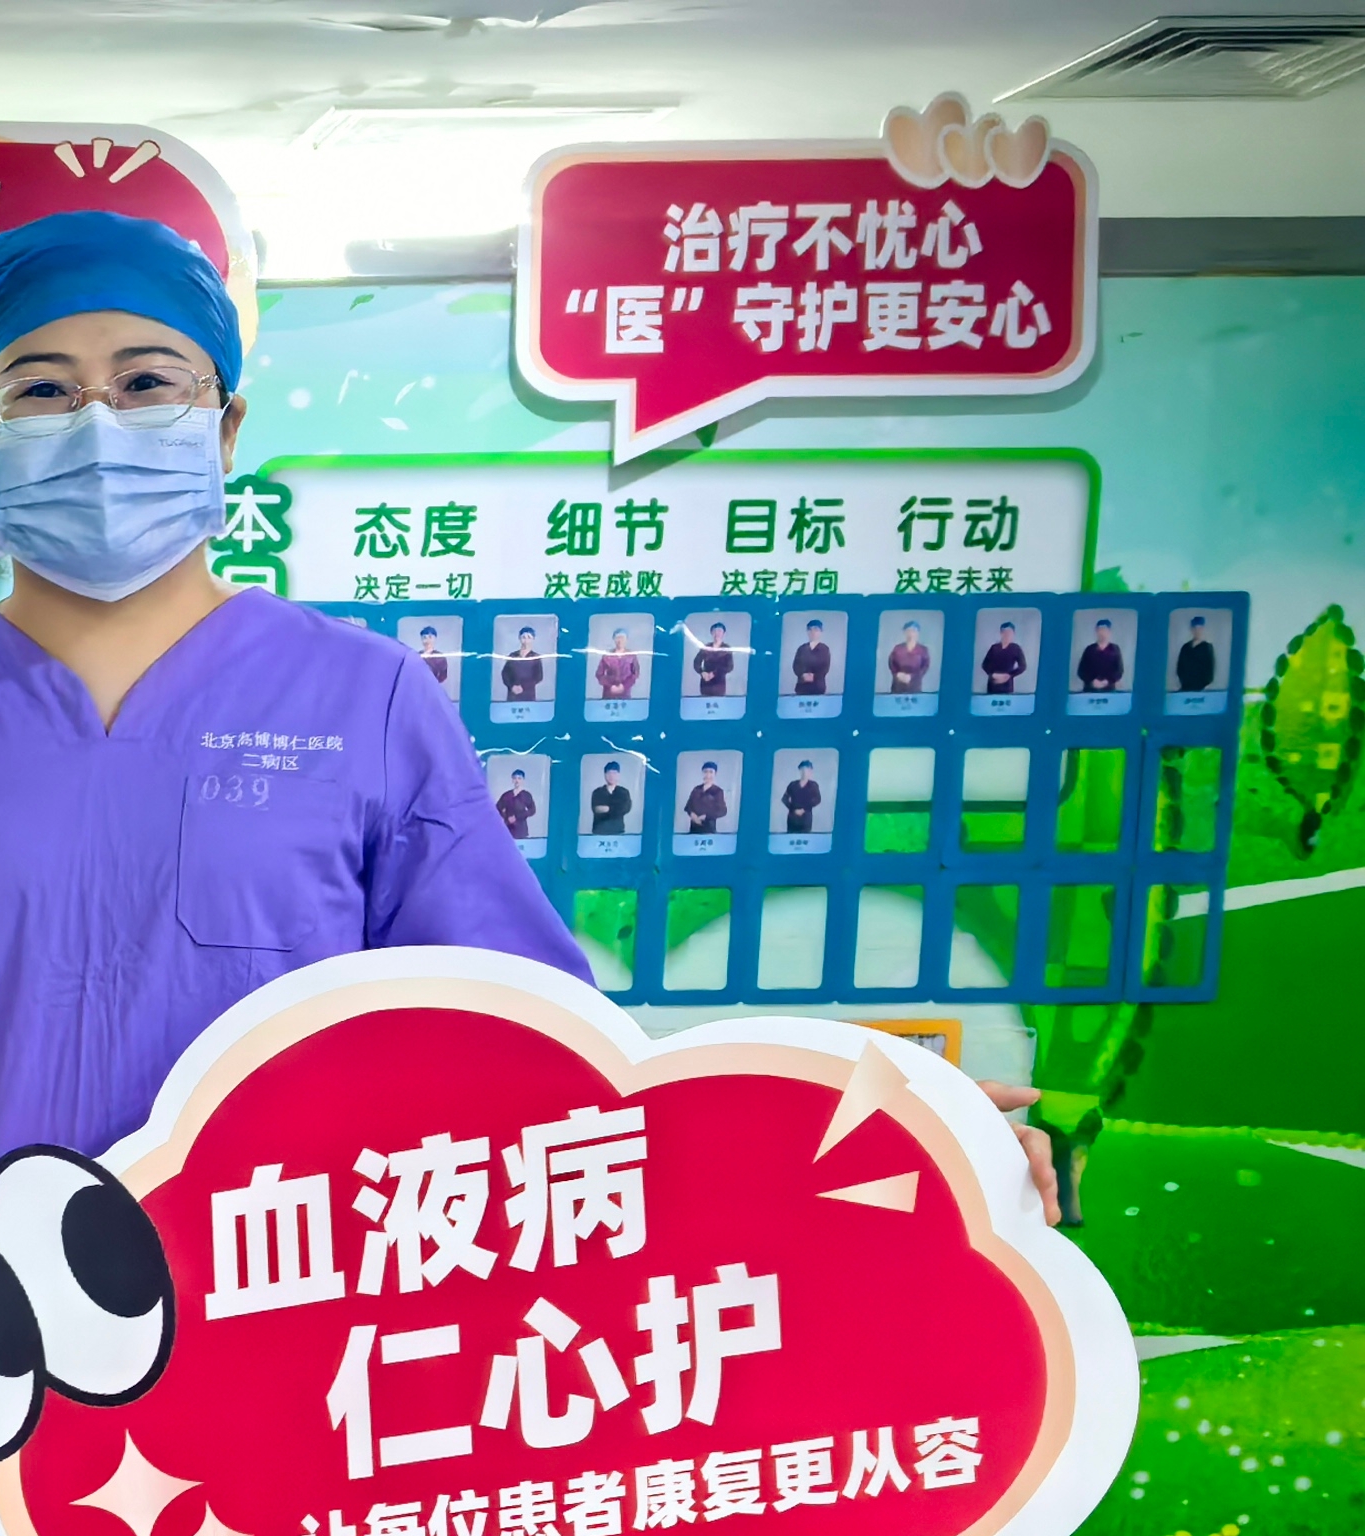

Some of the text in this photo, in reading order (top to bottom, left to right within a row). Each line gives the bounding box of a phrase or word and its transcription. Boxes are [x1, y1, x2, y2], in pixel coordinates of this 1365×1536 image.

[663, 200, 983, 272] 治疗不忧心
[353, 495, 1019, 558] 态度 细节 目标 行动
[354, 566, 1013, 600] 决定一切 决定成败 决定方向 决定未来
[203, 1103, 649, 1323] 血液病
[325, 1261, 783, 1481] 仁心护
